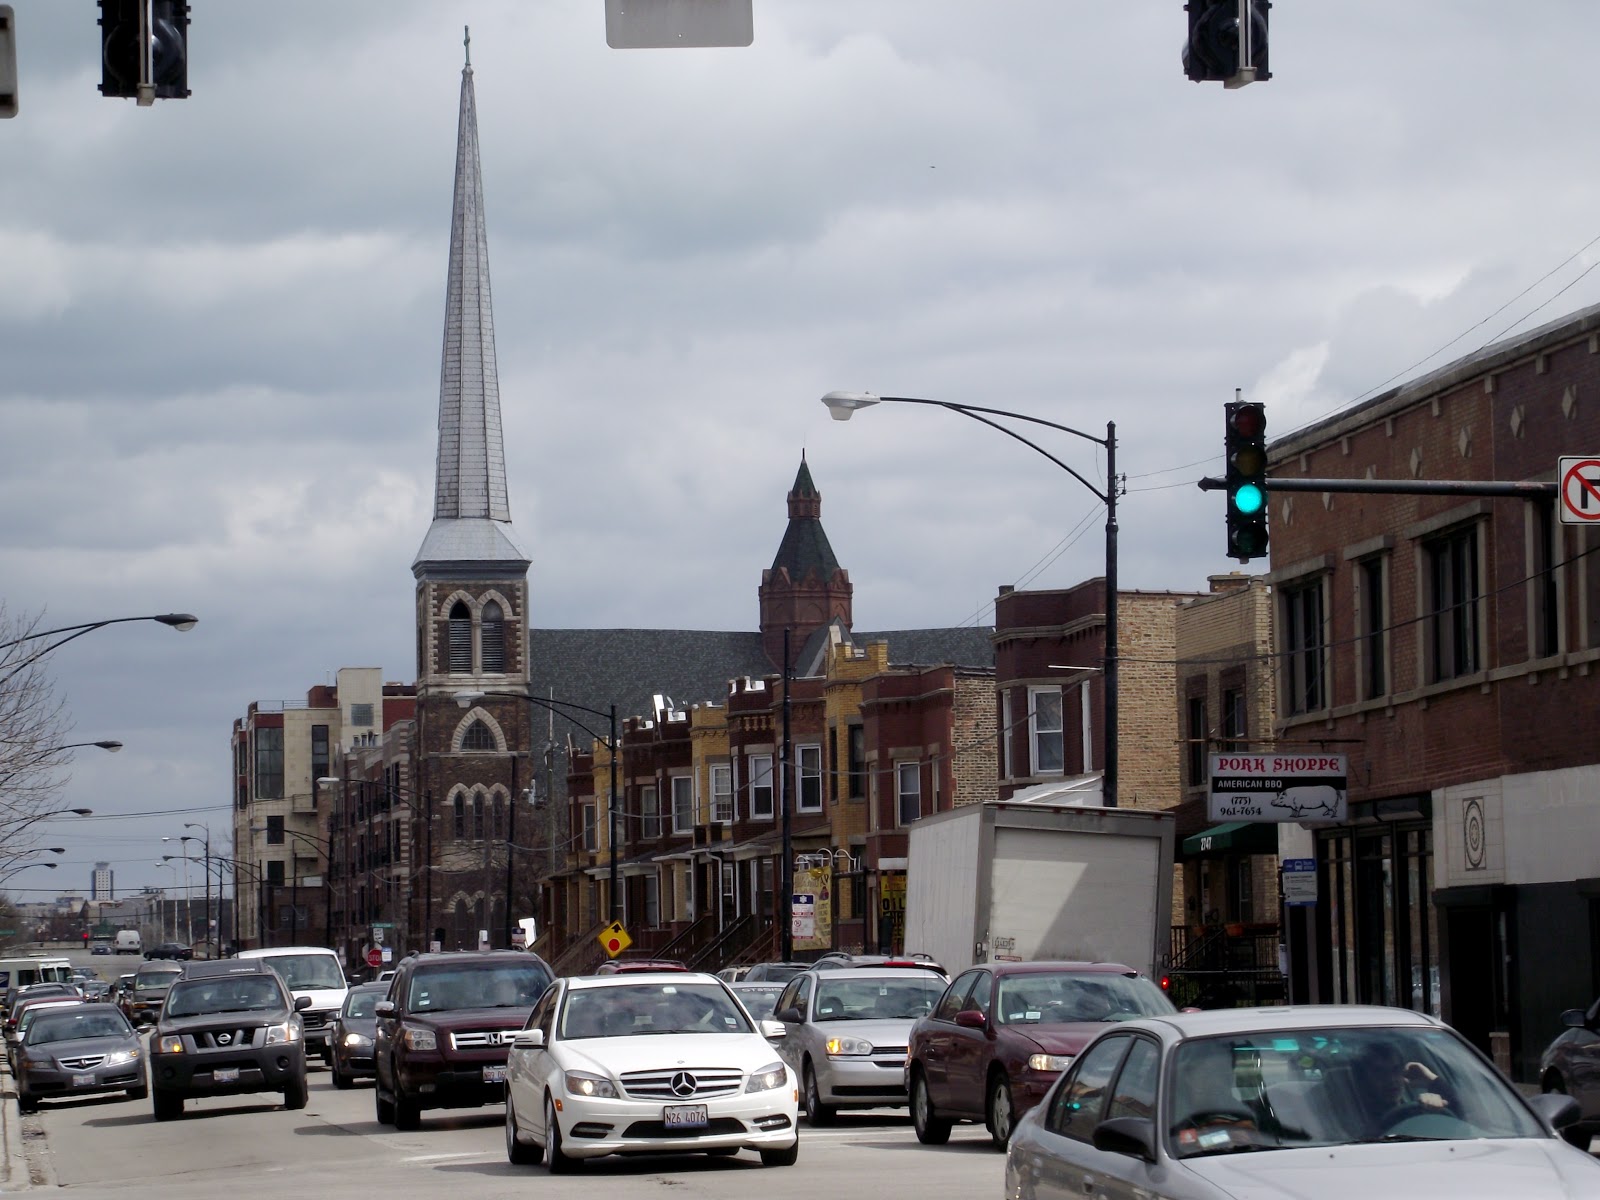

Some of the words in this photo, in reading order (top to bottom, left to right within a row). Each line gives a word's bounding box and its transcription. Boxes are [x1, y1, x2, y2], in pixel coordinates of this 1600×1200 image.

[1218, 757, 1265, 772] PORK
[1273, 757, 1340, 772] SHOPPE
[1218, 780, 1263, 788] AMERICAN
[1265, 780, 1282, 788] BBQ
[1231, 796, 1251, 805] (773)
[1220, 806, 1262, 816] 961-7654
[1200, 836, 1212, 851] 2747
[666, 1112, 681, 1124] N26
[686, 1111, 706, 1122] 4076
